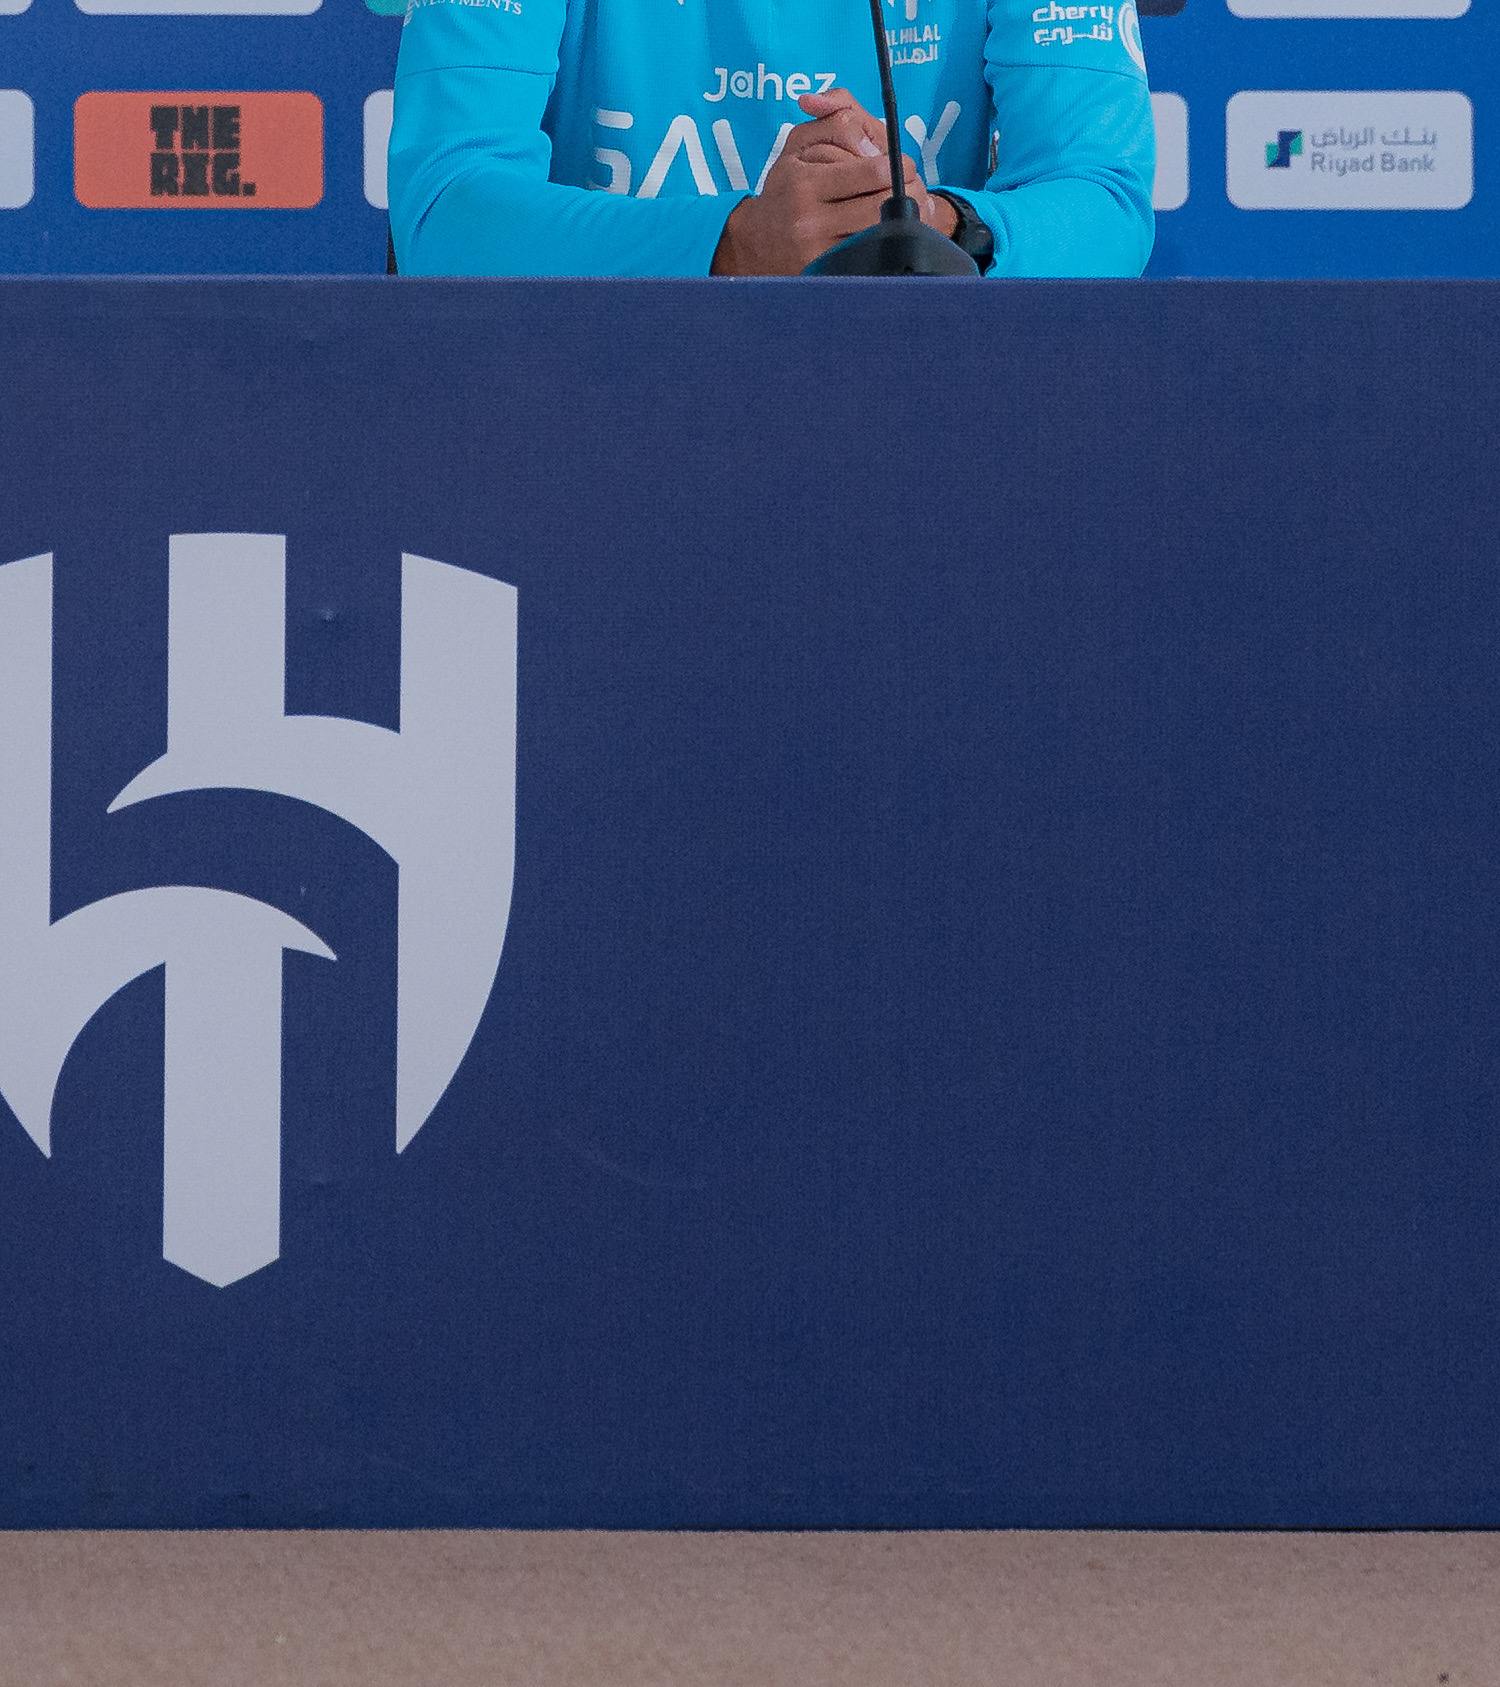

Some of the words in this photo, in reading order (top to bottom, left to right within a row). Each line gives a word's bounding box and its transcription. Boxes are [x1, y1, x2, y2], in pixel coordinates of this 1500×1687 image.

[1032, 0, 1114, 25] cherry
[151, 105, 241, 152] THE
[1311, 154, 1374, 177] Riyad
[1381, 154, 1435, 172] Bank
